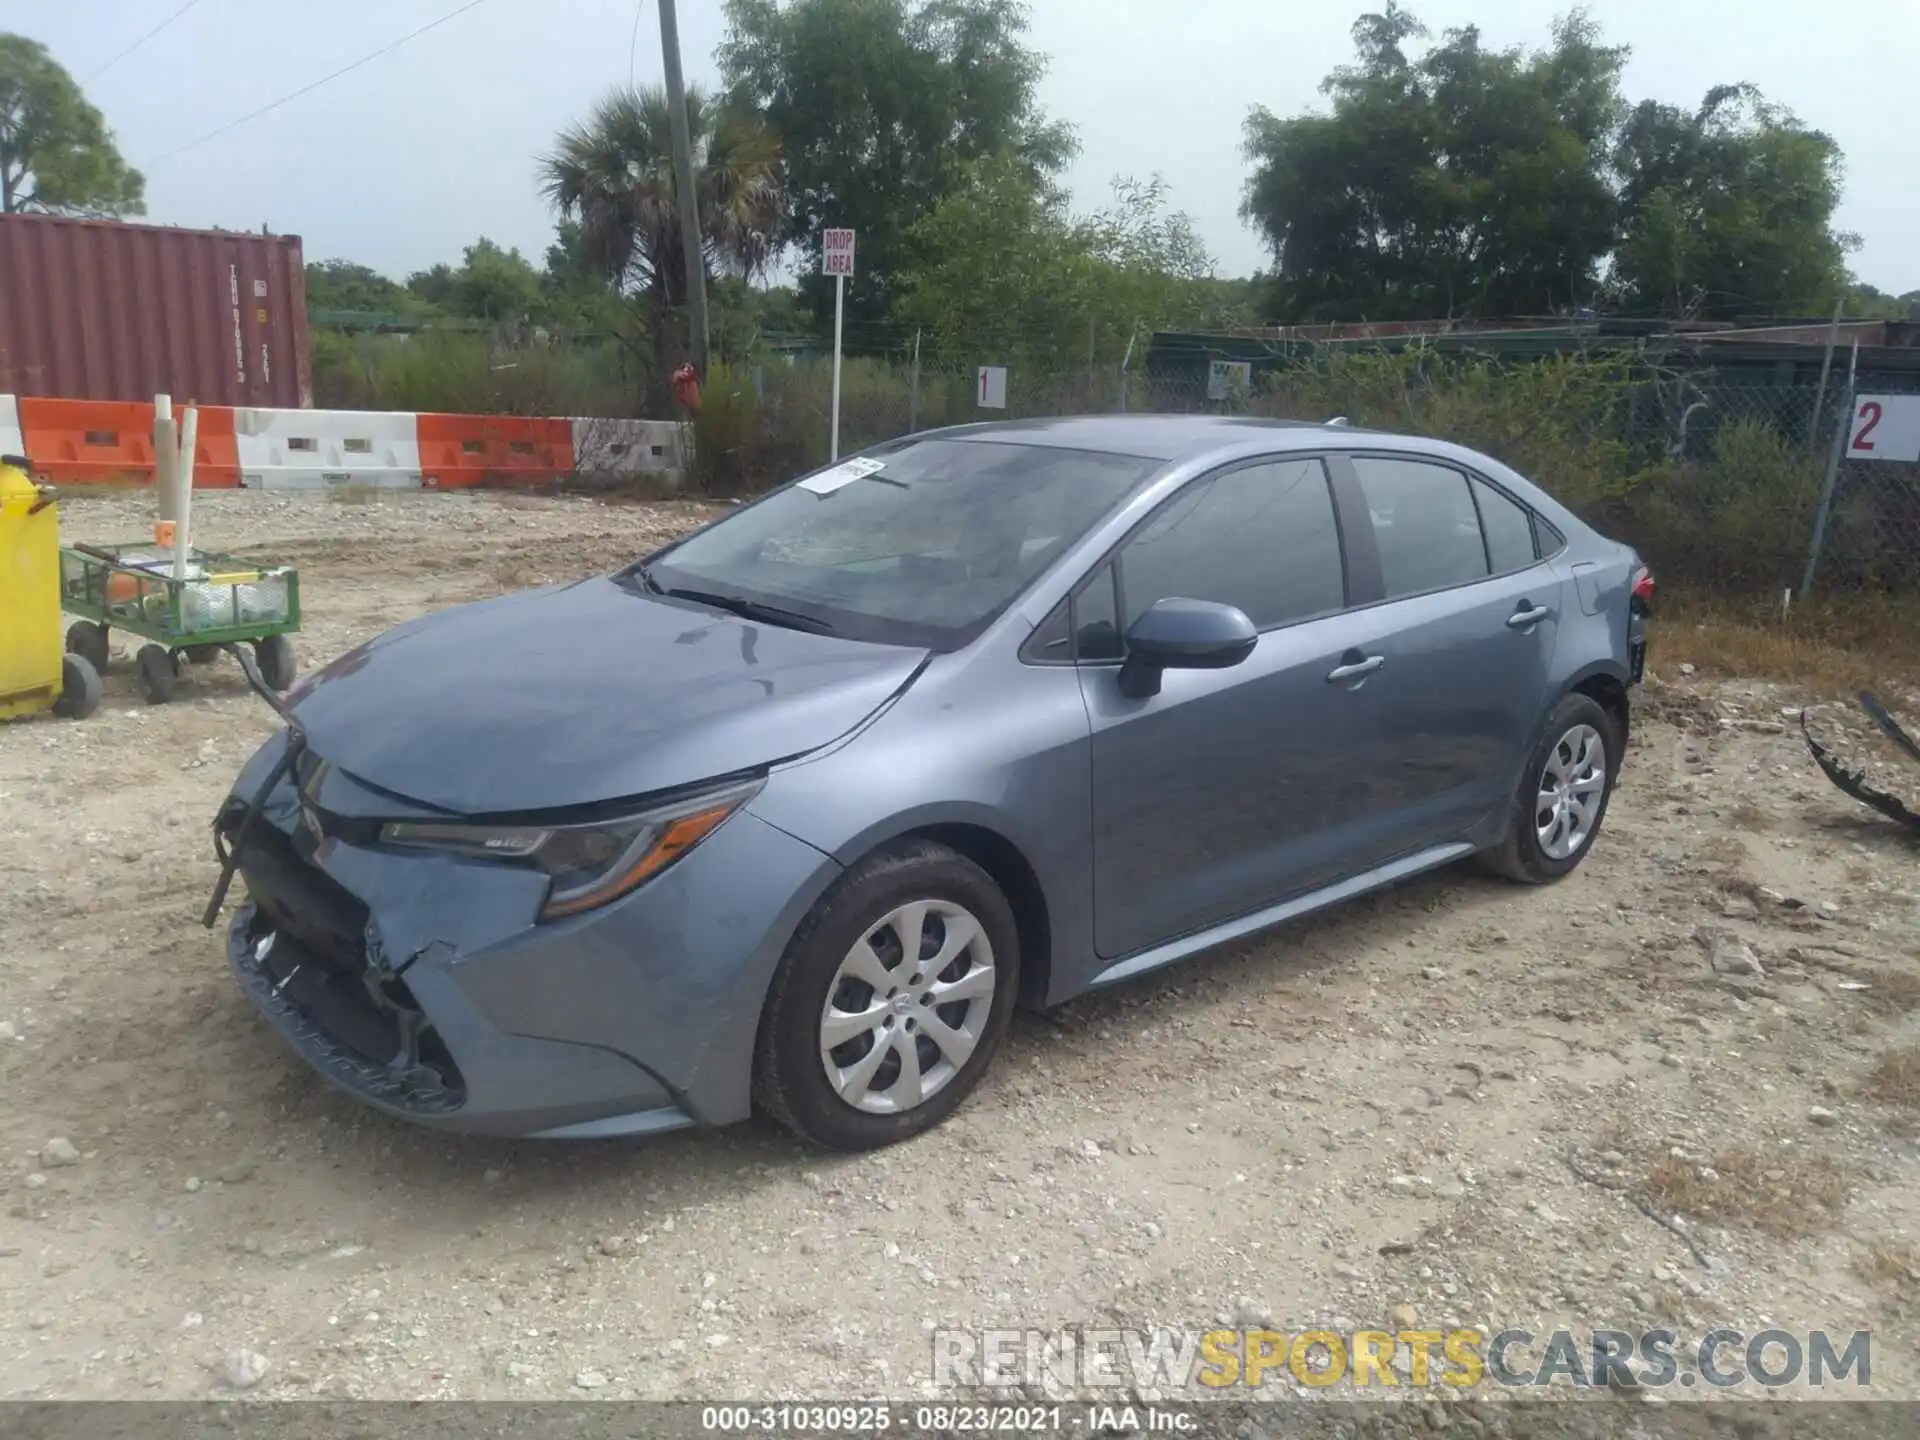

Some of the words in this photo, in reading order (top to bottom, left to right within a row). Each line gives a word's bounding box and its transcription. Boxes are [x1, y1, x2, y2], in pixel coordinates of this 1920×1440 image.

[826, 231, 853, 249] DROP
[826, 255, 852, 273] AREA
[980, 369, 988, 401] 1
[1852, 401, 1882, 450] 2
